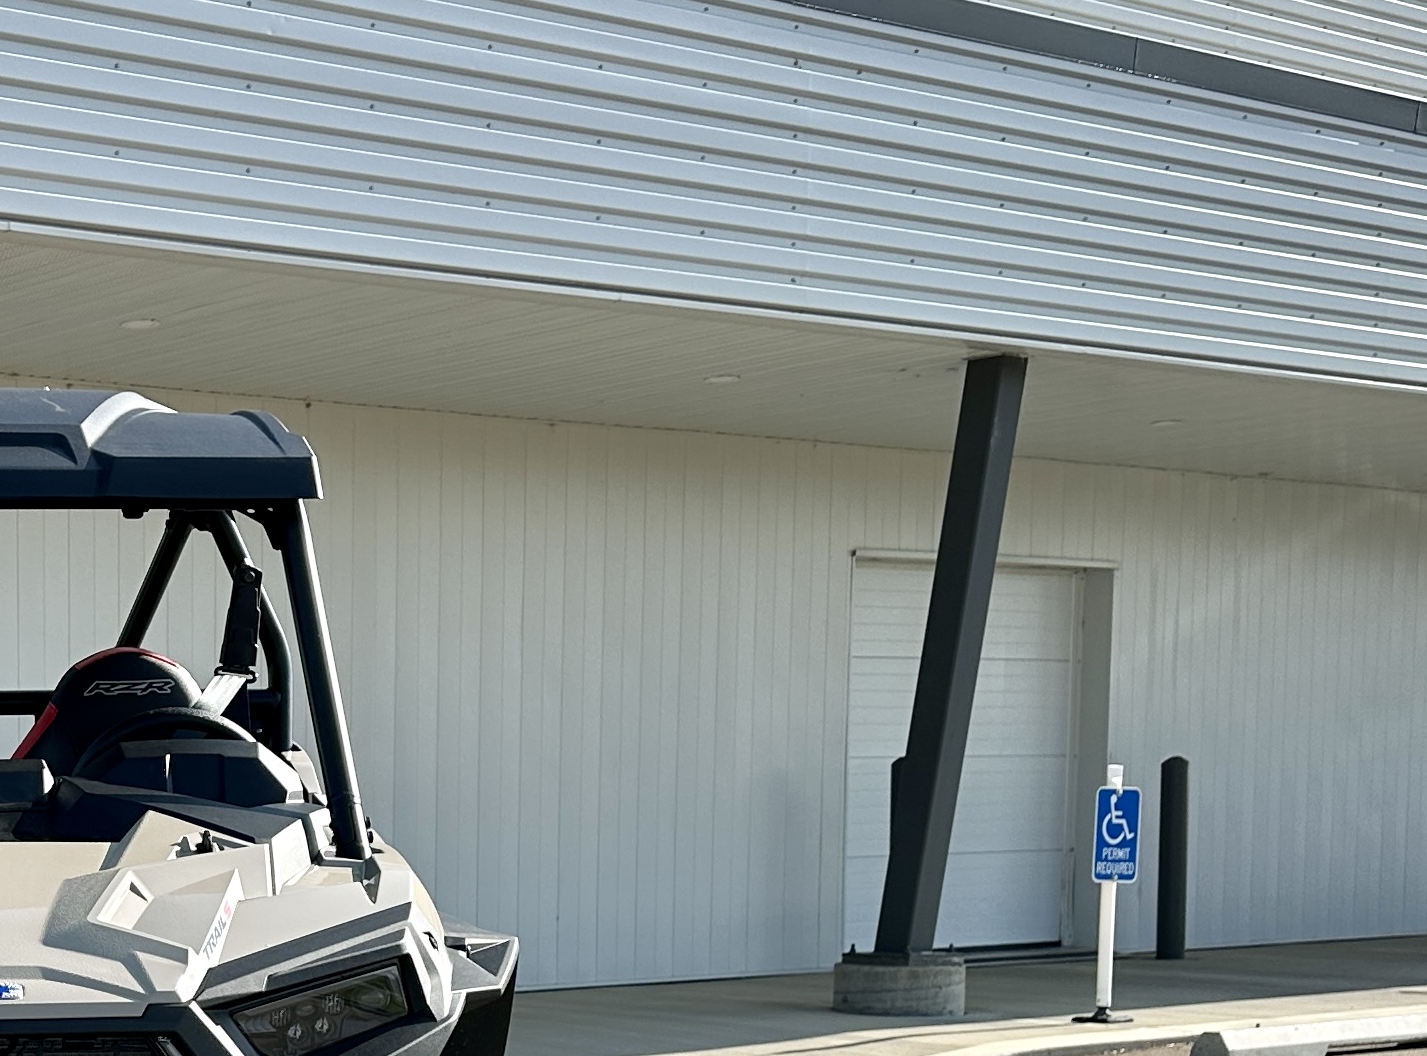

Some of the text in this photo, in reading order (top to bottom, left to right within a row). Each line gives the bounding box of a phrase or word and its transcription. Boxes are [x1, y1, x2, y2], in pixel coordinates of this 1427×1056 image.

[84, 679, 175, 696] RZR
[1102, 847, 1130, 860] PERMIT
[1096, 861, 1134, 875] REQUIRED
[203, 915, 226, 960] TRAIL
